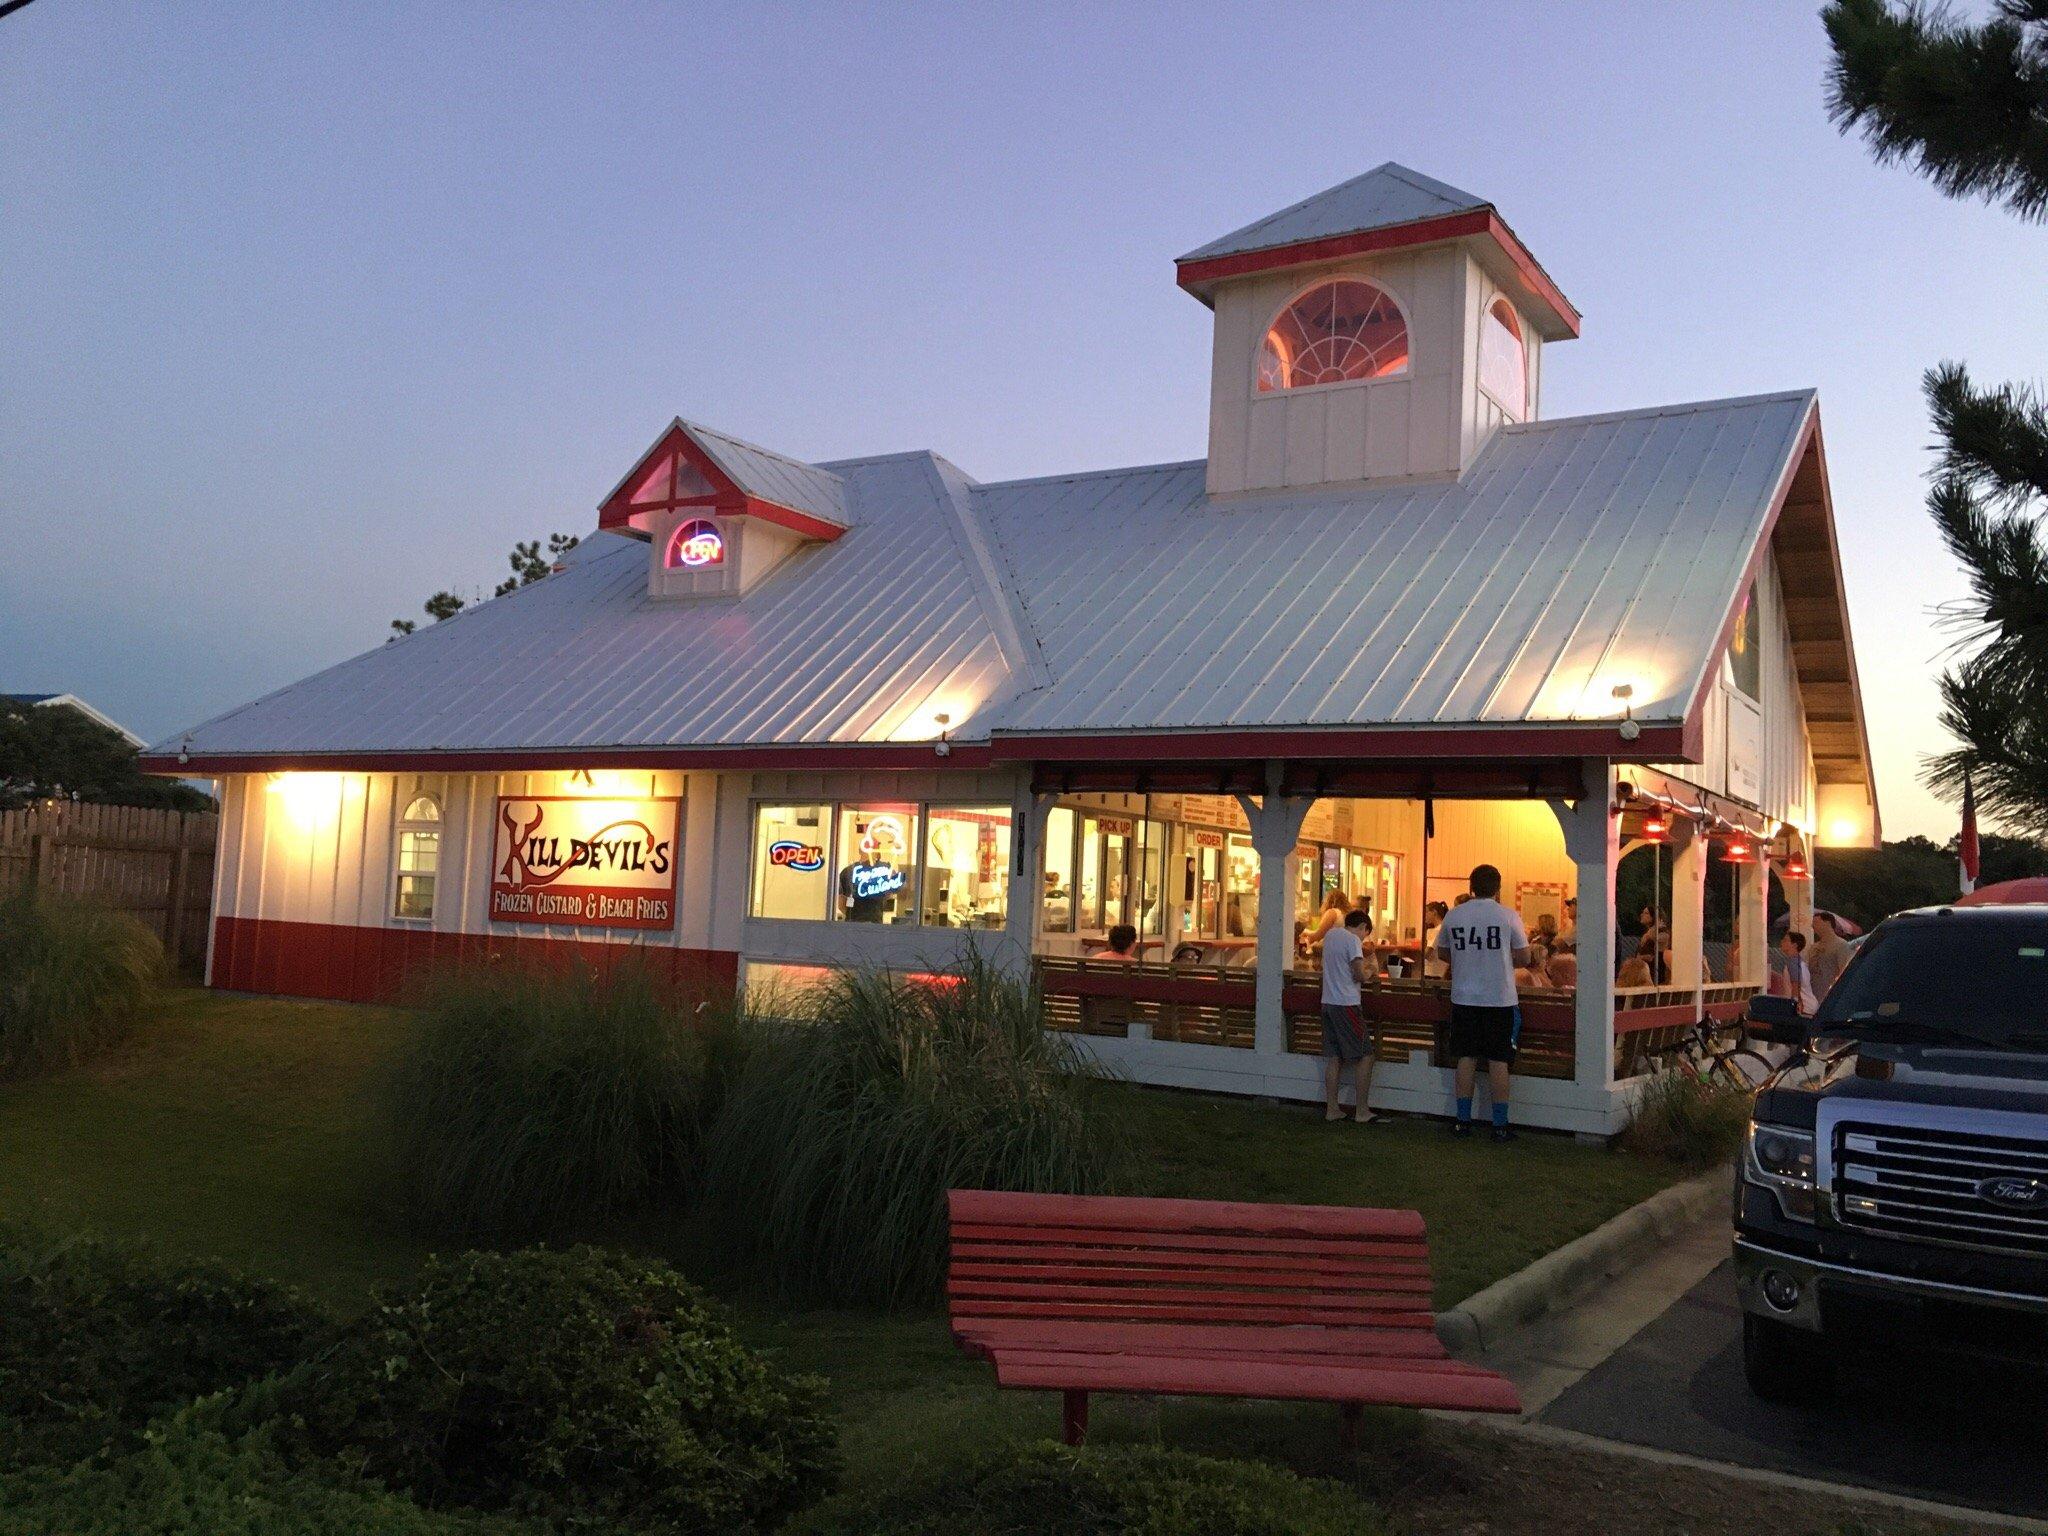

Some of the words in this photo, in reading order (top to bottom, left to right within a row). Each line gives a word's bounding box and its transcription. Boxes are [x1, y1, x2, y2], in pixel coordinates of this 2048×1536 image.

[1100, 818, 1118, 834] PICK
[1120, 821, 1131, 834] UP
[501, 803, 563, 890] KILL
[569, 834, 671, 874] DEVIL'S
[1196, 833, 1221, 847] ORDER
[772, 848, 819, 864] OPEN
[494, 890, 533, 913] FROZEN
[536, 892, 582, 916] CUSTARD
[586, 893, 597, 919] &
[600, 895, 634, 919] BEACH
[636, 896, 668, 921] FRIES
[1451, 925, 1501, 951] 548
[1993, 1181, 2038, 1200] Ford
